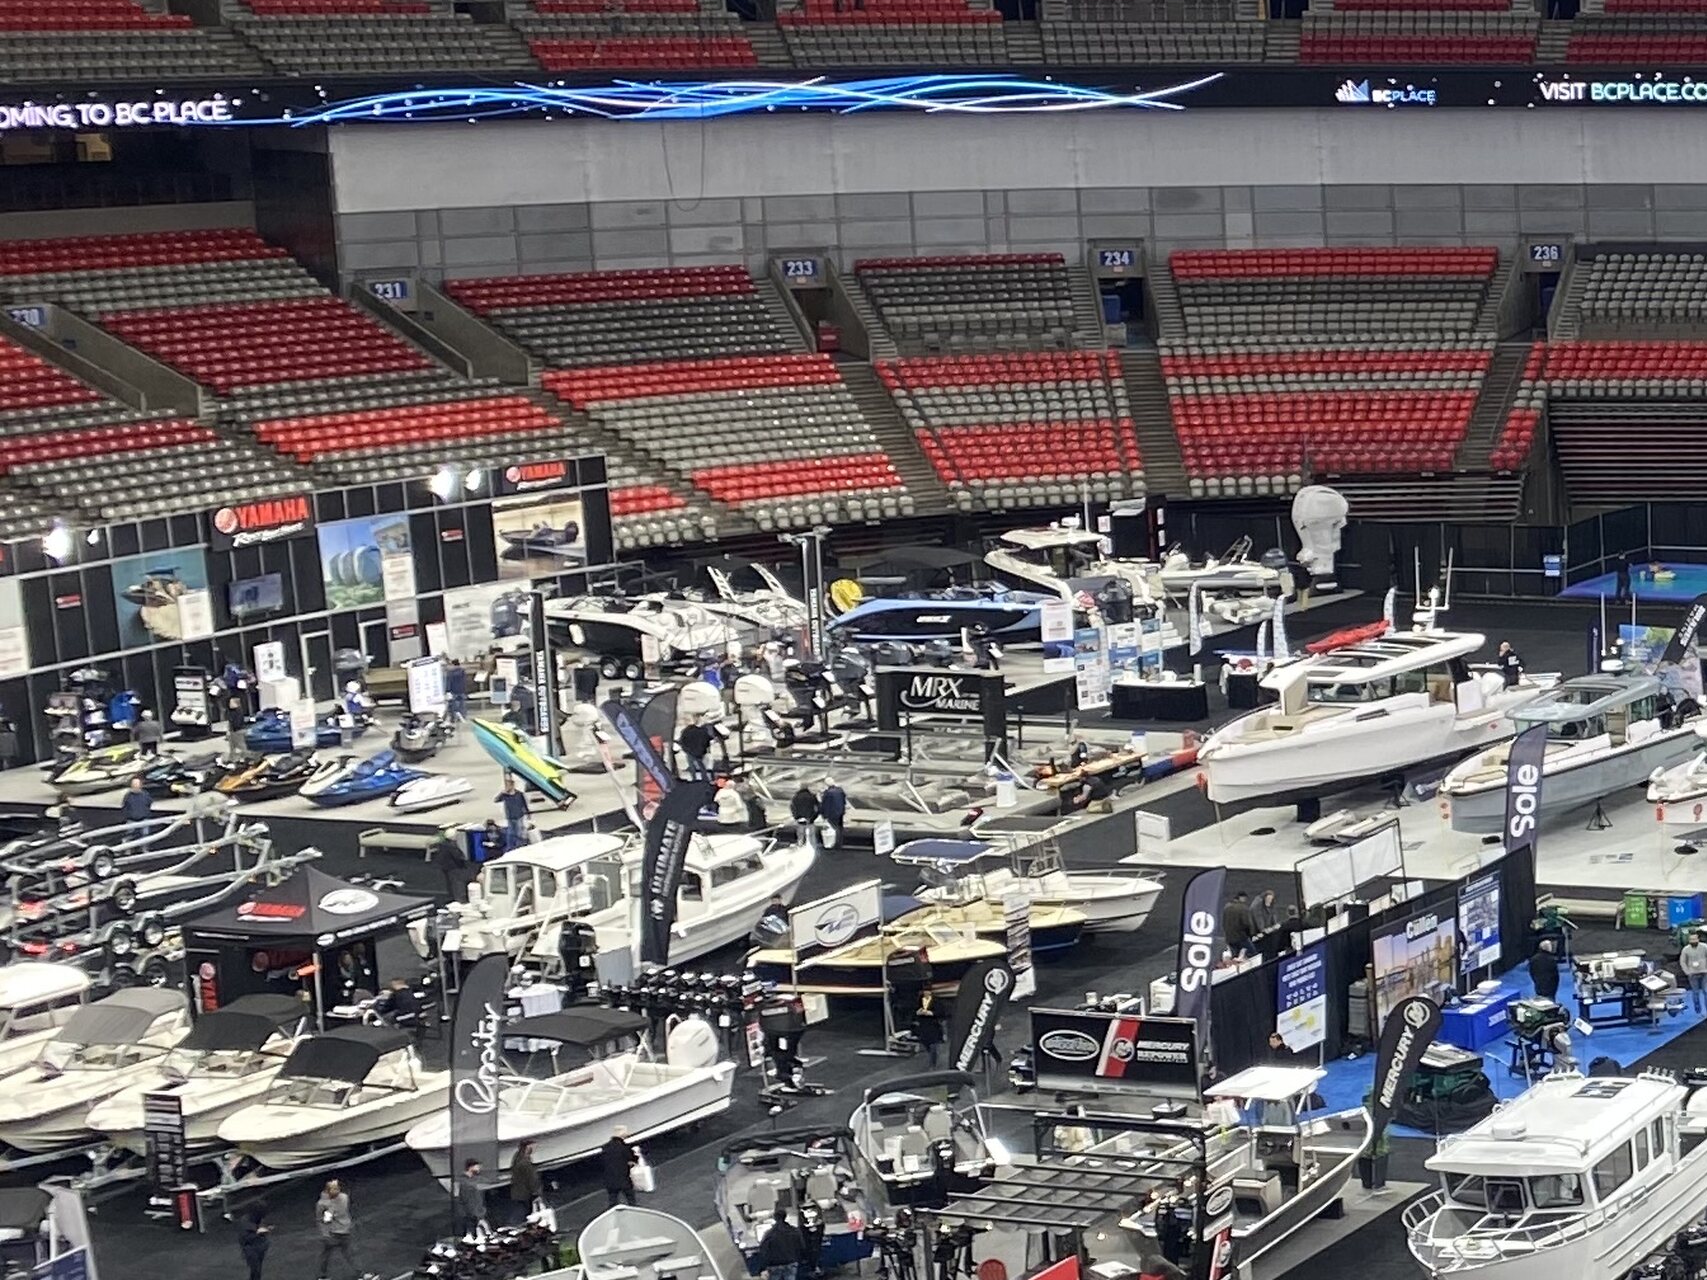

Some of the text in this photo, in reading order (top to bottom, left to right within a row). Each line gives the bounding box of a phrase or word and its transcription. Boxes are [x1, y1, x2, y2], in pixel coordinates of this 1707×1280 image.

[1540, 82, 1586, 101] VISIT
[76, 103, 111, 125] TO
[114, 102, 149, 125] BC
[1104, 251, 1129, 266] 234
[1533, 246, 1558, 260] 236
[787, 261, 813, 277] 233
[375, 282, 401, 299] 231
[236, 497, 310, 530] YAMAHA
[911, 676, 964, 699] MRX
[935, 698, 980, 711] MARINE
[1510, 764, 1539, 838] Sole
[1180, 911, 1215, 993] Sole
[956, 991, 998, 1072] MERCURY
[1136, 1039, 1190, 1051] MERCURY
[455, 1001, 502, 1113] Rossiter
[1379, 1025, 1415, 1109] MERCURY
